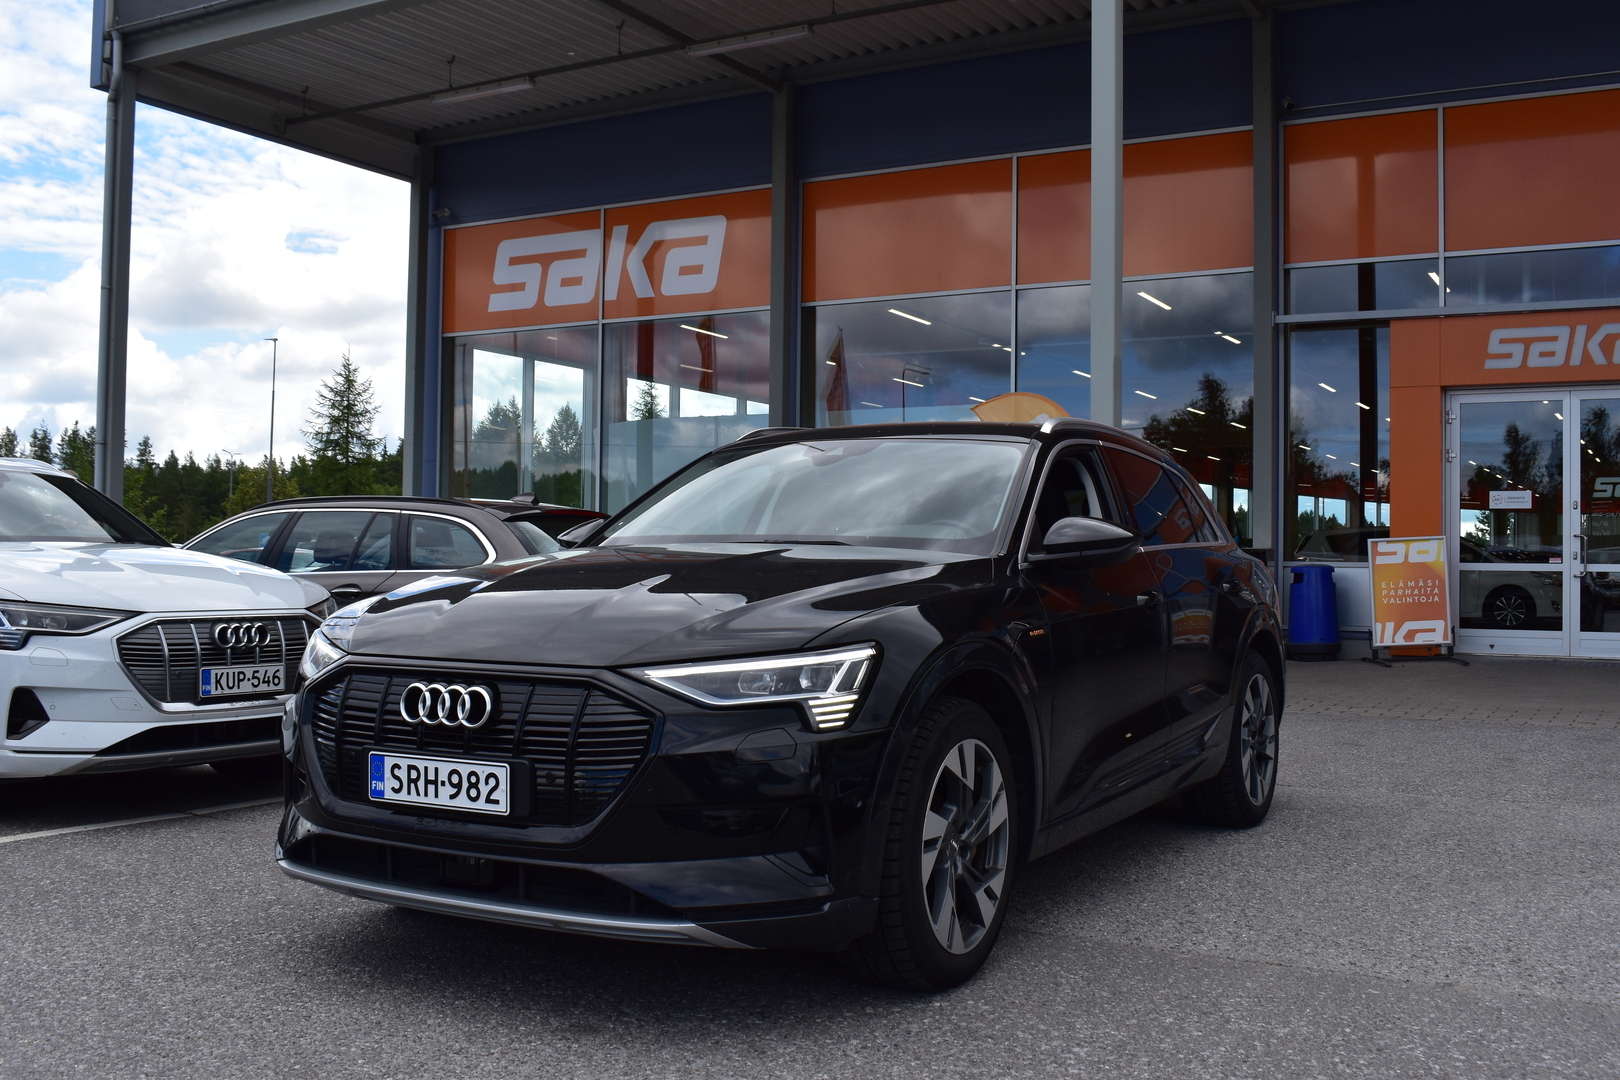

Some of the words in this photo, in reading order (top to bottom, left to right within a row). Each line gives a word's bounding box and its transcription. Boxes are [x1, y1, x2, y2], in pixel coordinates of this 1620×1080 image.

[1484, 323, 1620, 369] sak
[1381, 579, 1439, 588] ELÄMÄSI
[1382, 588, 1439, 596] PARHAITA
[1382, 596, 1440, 604] VALINTOJA
[214, 669, 281, 691] KUP-546
[371, 780, 384, 791] FIN
[390, 762, 500, 805] SRH-982
